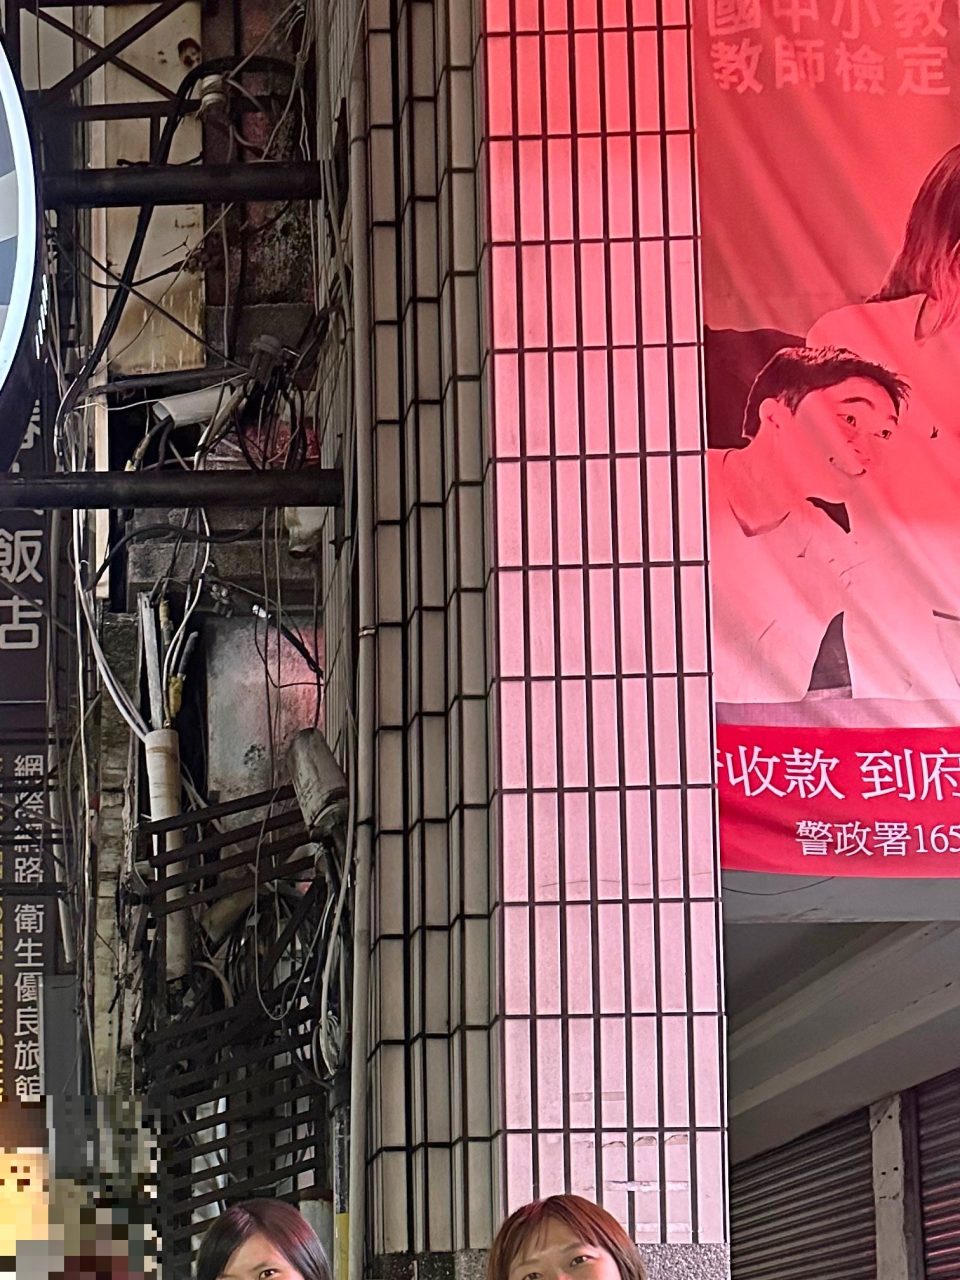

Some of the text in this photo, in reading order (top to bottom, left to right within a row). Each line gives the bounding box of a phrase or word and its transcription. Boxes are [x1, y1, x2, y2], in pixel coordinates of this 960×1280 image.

[707, 0, 960, 39] 國中小教
[709, 38, 951, 96] 教師檢定
[717, 745, 960, 801] 收款 到府
[795, 820, 960, 857] 警政署165
